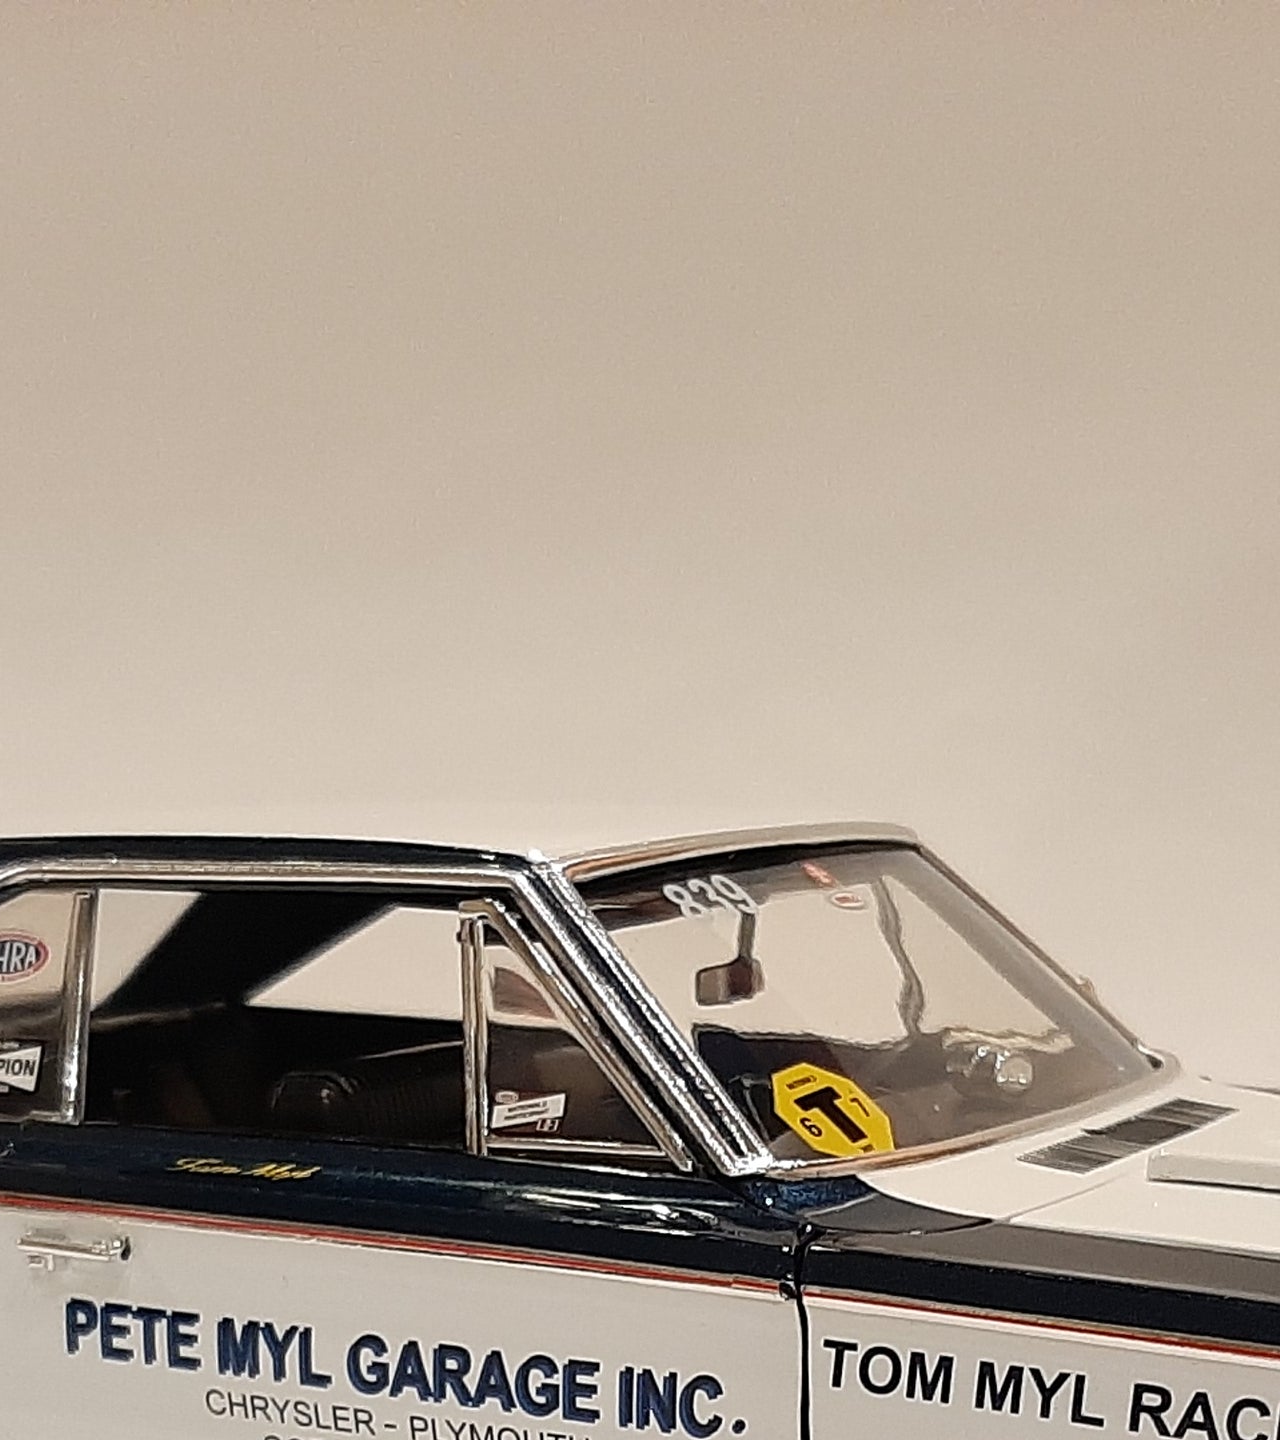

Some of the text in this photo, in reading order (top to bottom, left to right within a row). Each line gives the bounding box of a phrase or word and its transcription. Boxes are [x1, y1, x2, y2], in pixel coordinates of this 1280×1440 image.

[793, 1086, 869, 1144] T
[66, 1298, 746, 1438] PETE MYL GARAGE INC.
[824, 1339, 954, 1403] TOM
[974, 1361, 1105, 1427] MYL
[206, 1389, 375, 1436] CHRYSLER
